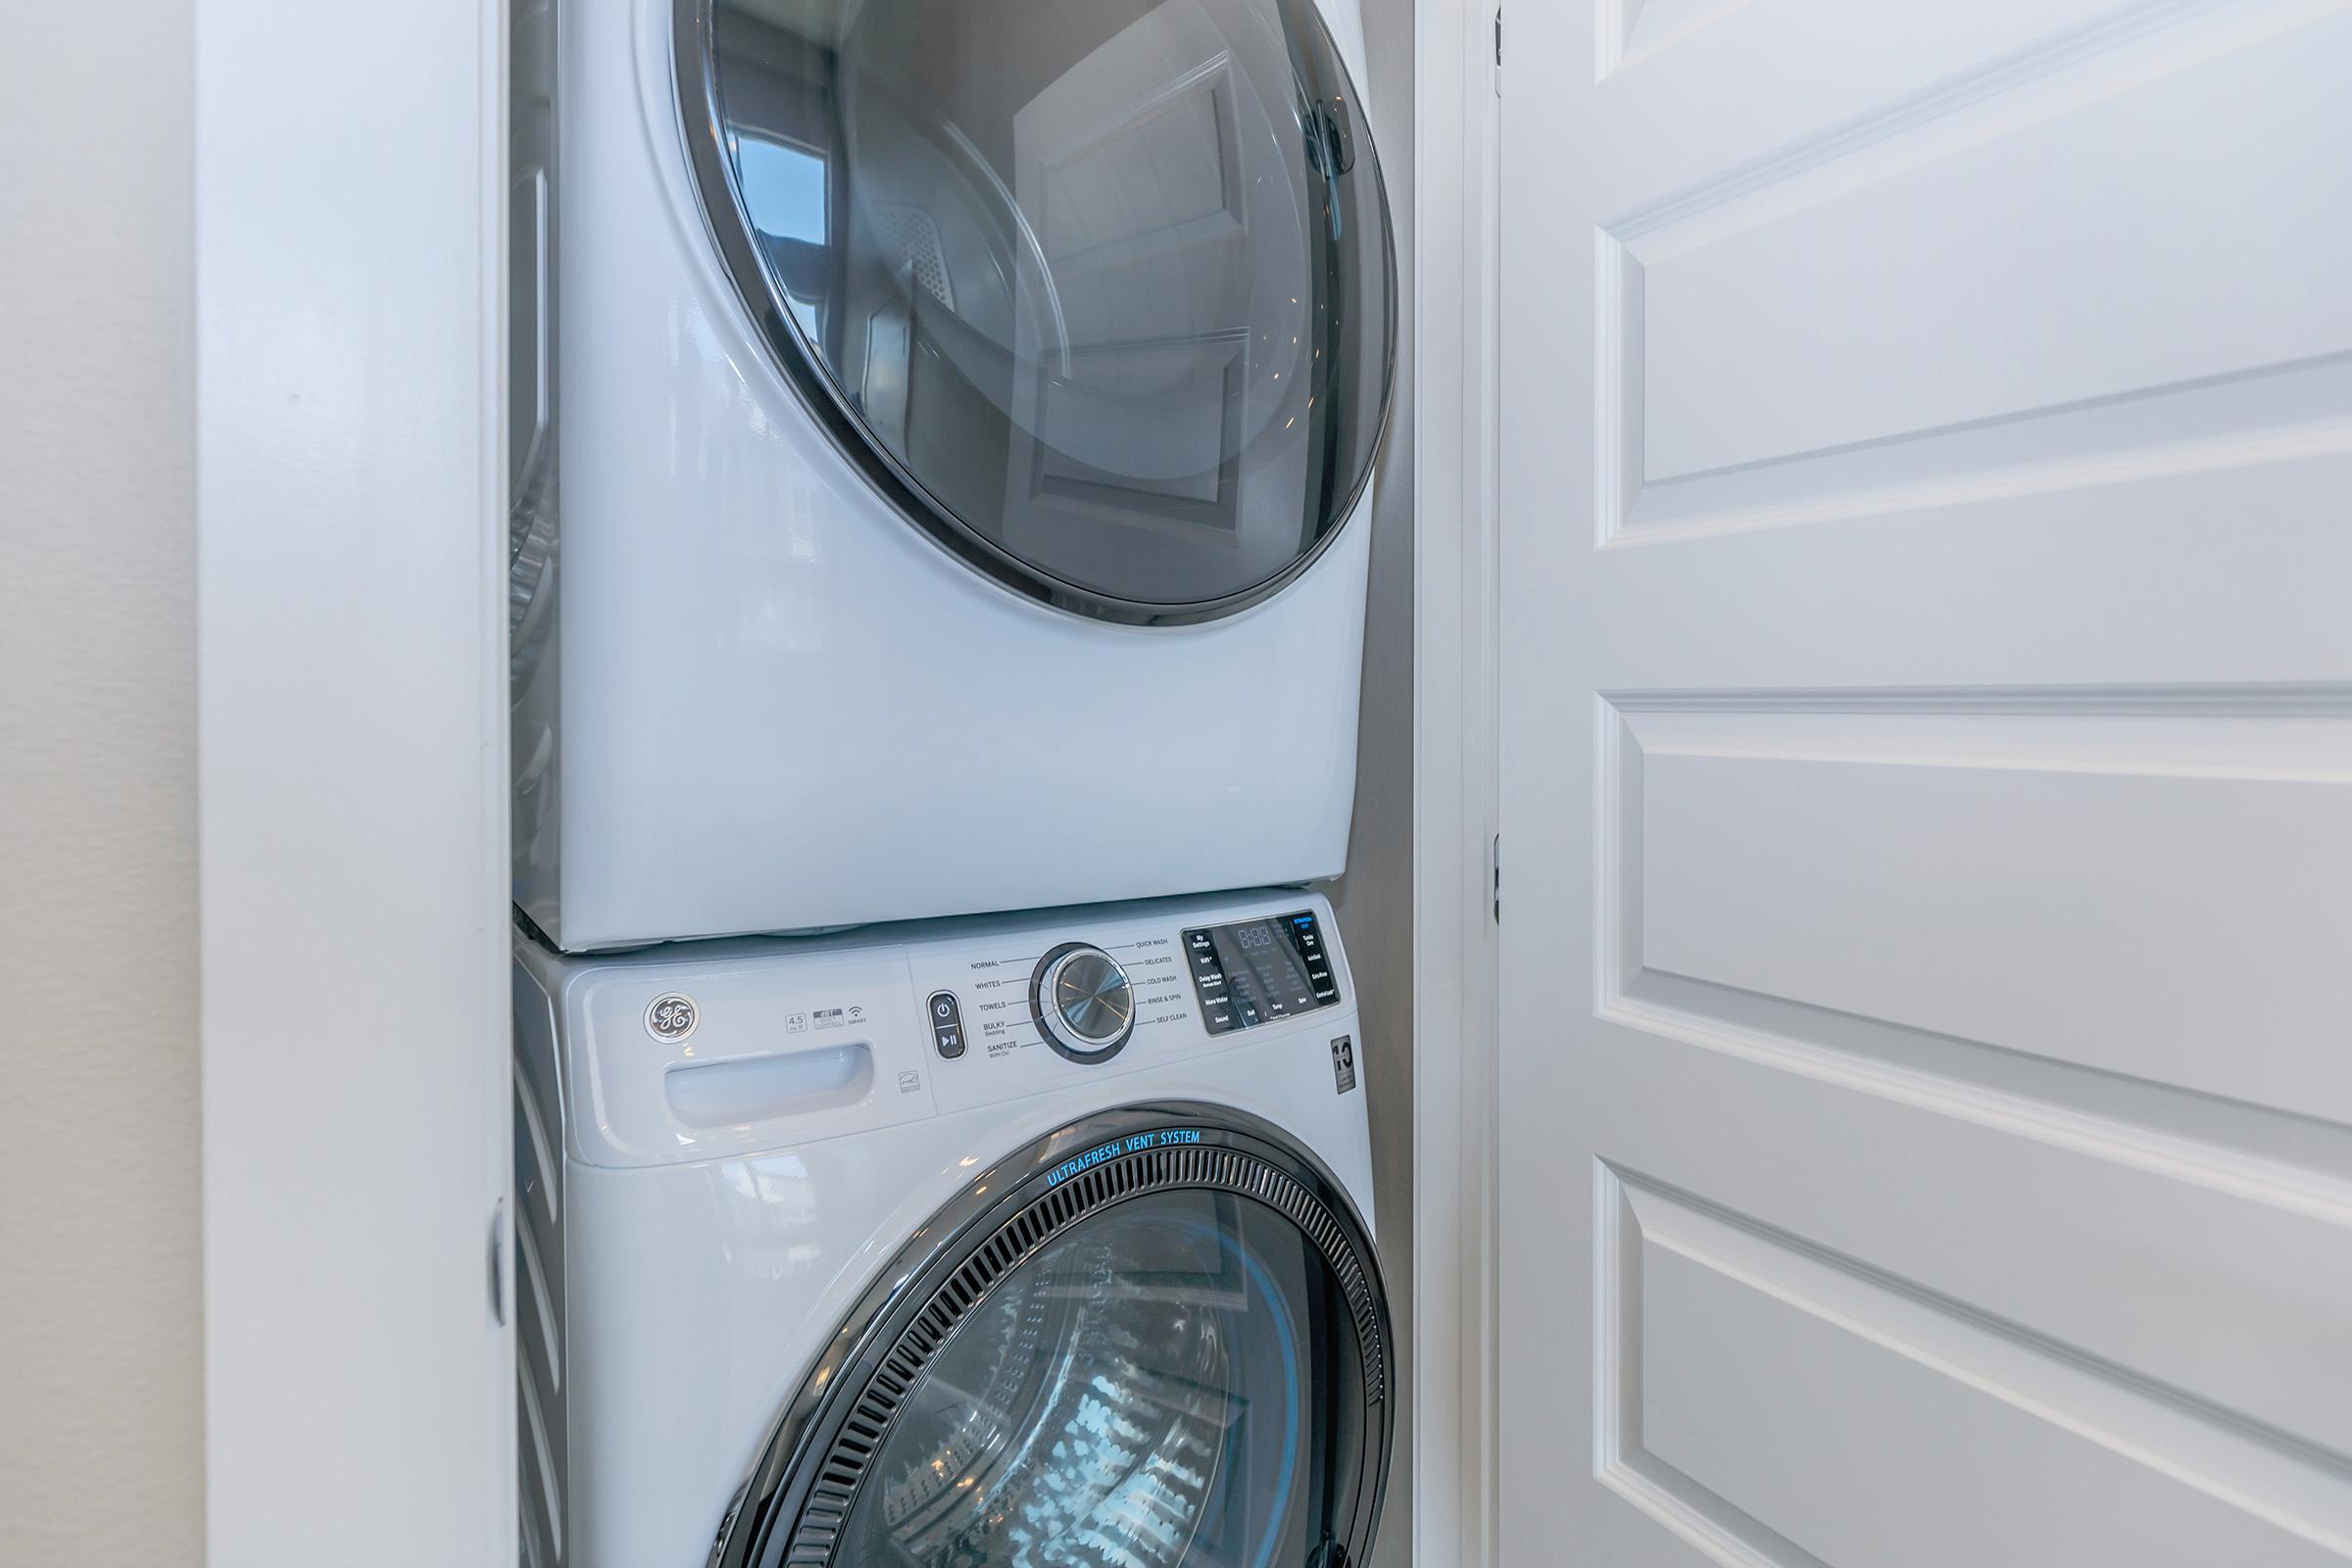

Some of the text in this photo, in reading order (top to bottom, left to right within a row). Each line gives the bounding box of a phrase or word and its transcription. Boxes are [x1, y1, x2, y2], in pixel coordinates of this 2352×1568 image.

[1136, 940, 1152, 949] QUICK
[970, 960, 1000, 970] NORMAL
[1145, 956, 1173, 965] DELICATES
[975, 980, 1002, 990] WHITES
[1148, 996, 1164, 1004] RINSE
[979, 1002, 1006, 1011] TOWELS
[788, 1015, 804, 1025] 4.5
[983, 1021, 1005, 1031] BULKY
[988, 1041, 1018, 1053] SANITIZE
[1047, 1130, 1200, 1187] ULTRAFRESH VENT SYSTEM
